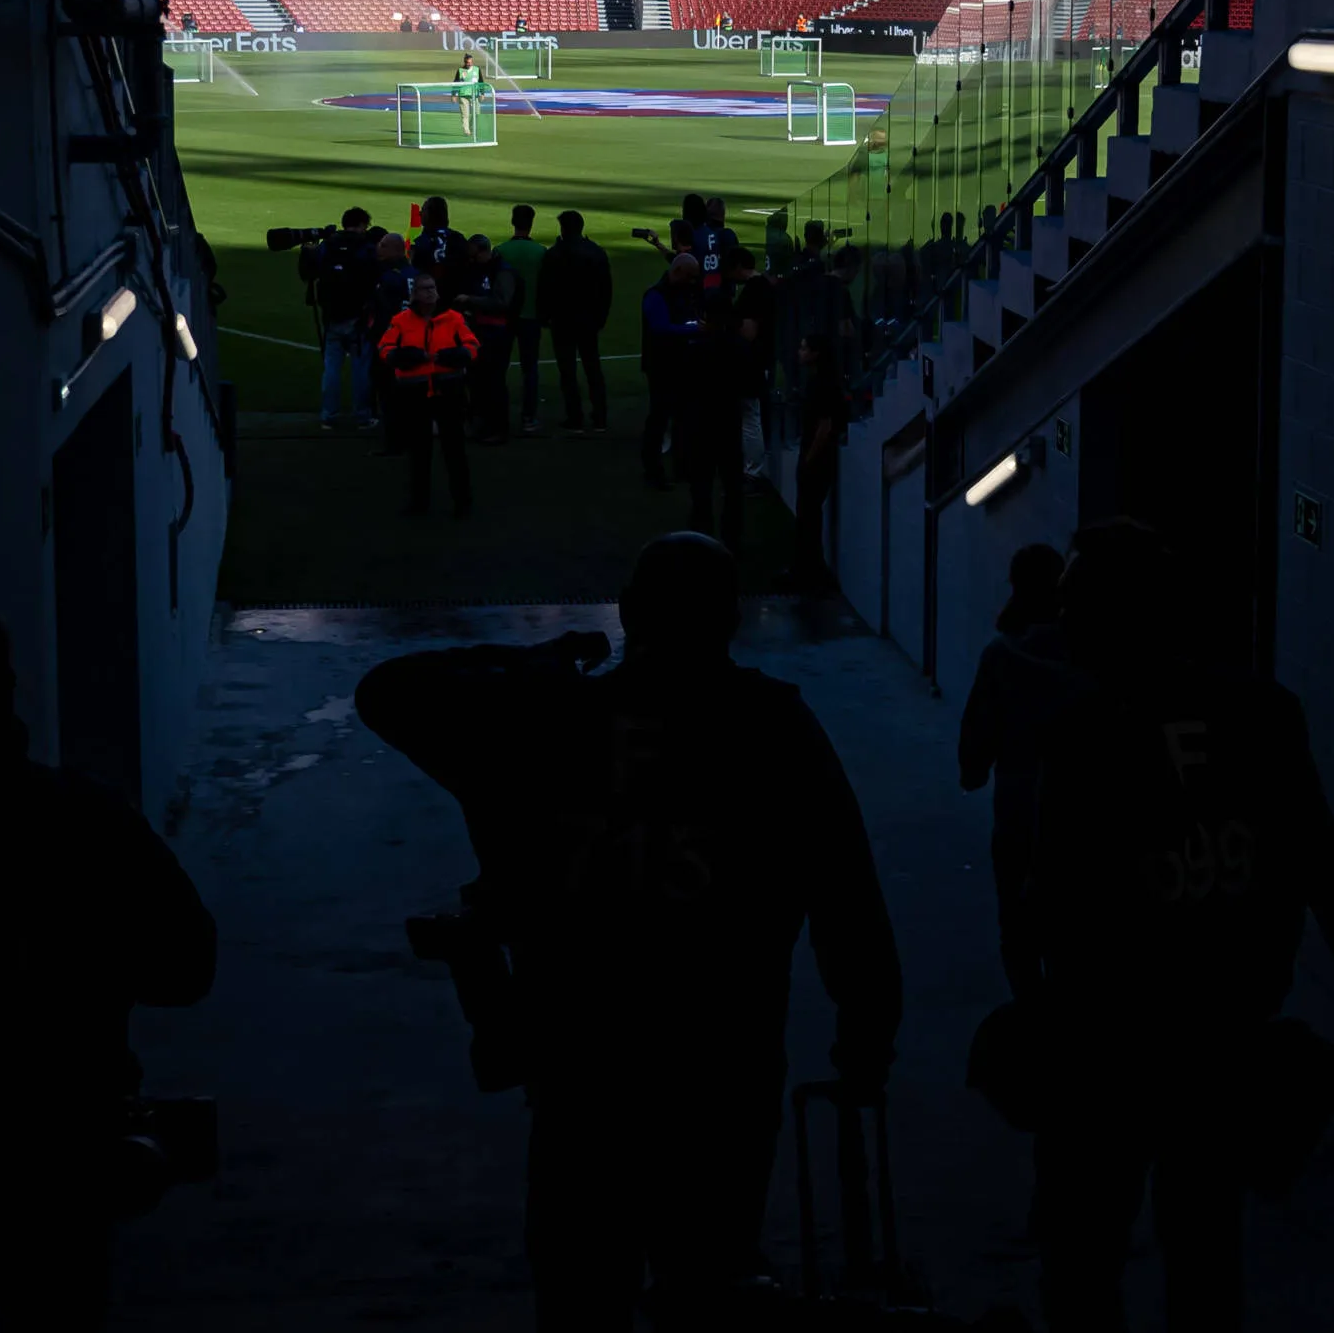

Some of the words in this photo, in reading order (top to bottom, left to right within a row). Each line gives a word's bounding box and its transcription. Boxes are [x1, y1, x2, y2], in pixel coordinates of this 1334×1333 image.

[236, 32, 297, 53] Eats
[442, 30, 499, 51] Uber
[501, 31, 559, 51] Eats
[693, 29, 753, 50] Uber
[757, 29, 804, 52] Eats
[707, 233, 716, 251] F
[1162, 720, 1208, 788] F
